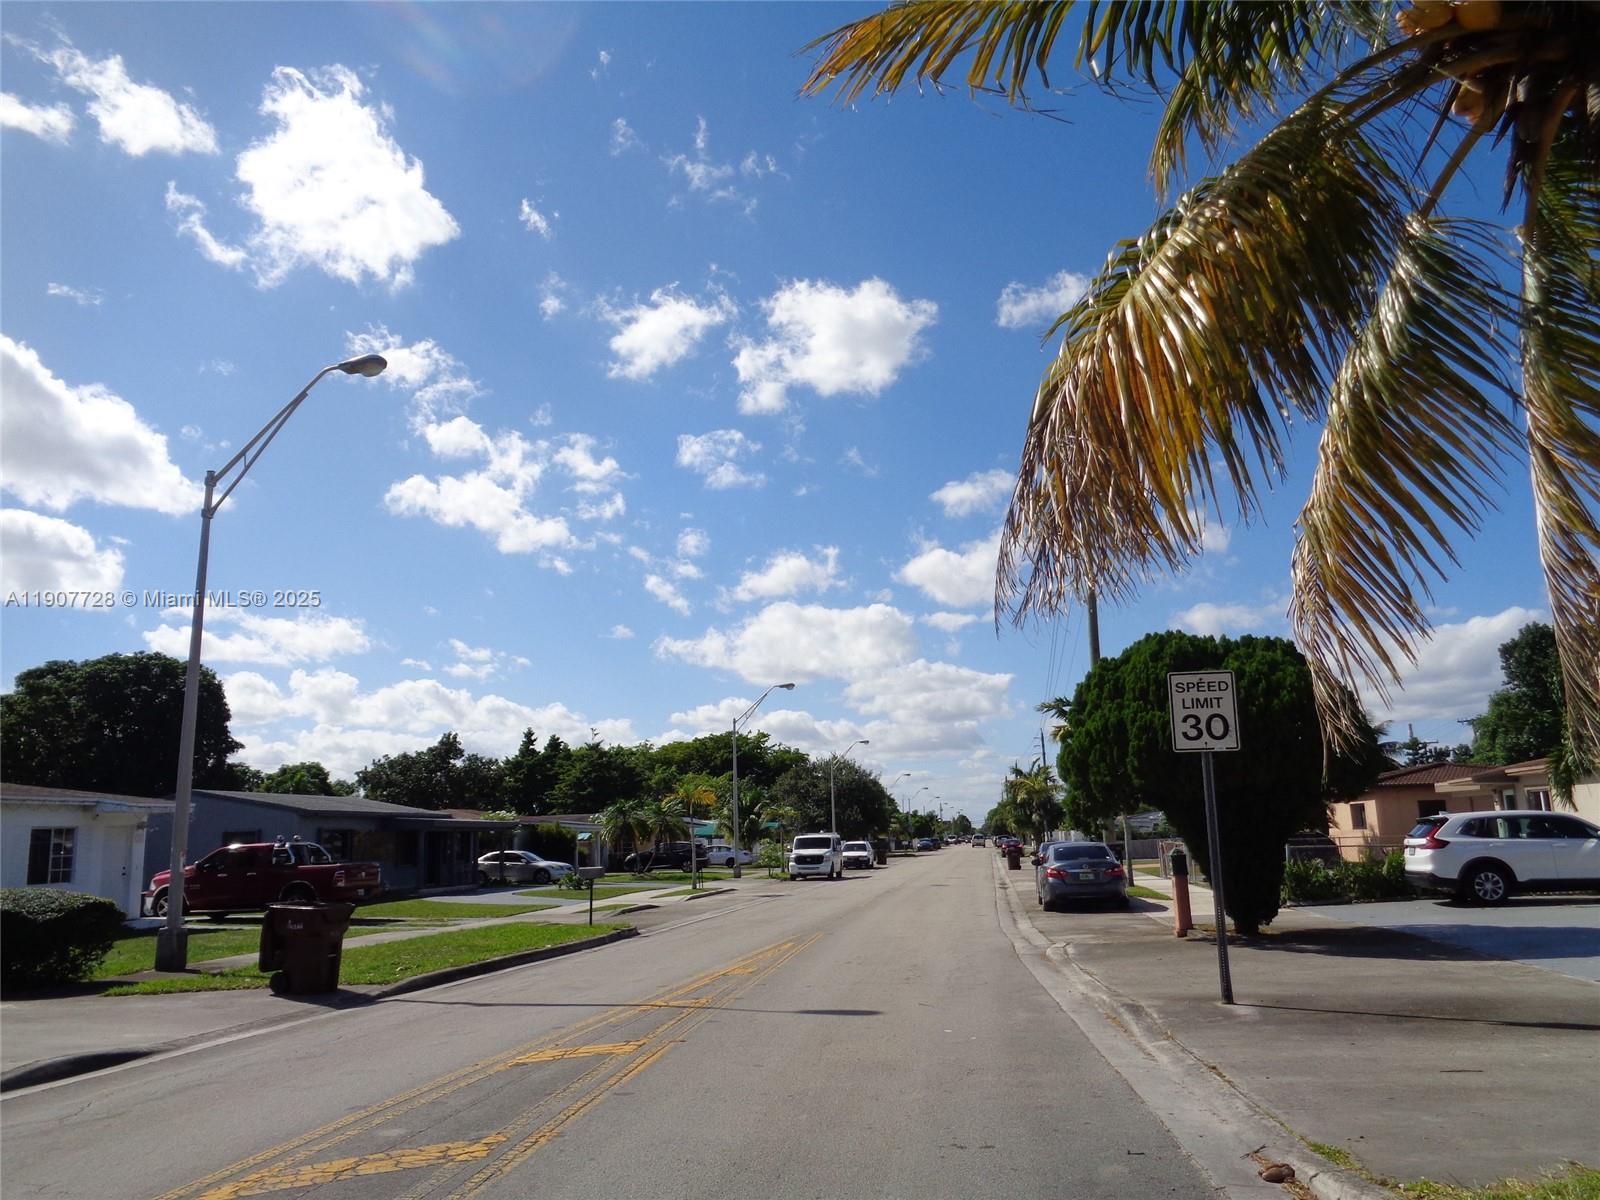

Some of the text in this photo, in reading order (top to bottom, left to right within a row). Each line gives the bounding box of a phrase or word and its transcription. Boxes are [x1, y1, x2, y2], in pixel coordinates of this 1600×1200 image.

[1175, 681, 1229, 693] SPEED
[1181, 697, 1223, 709] LIMIT
[1181, 713, 1230, 741] 30
